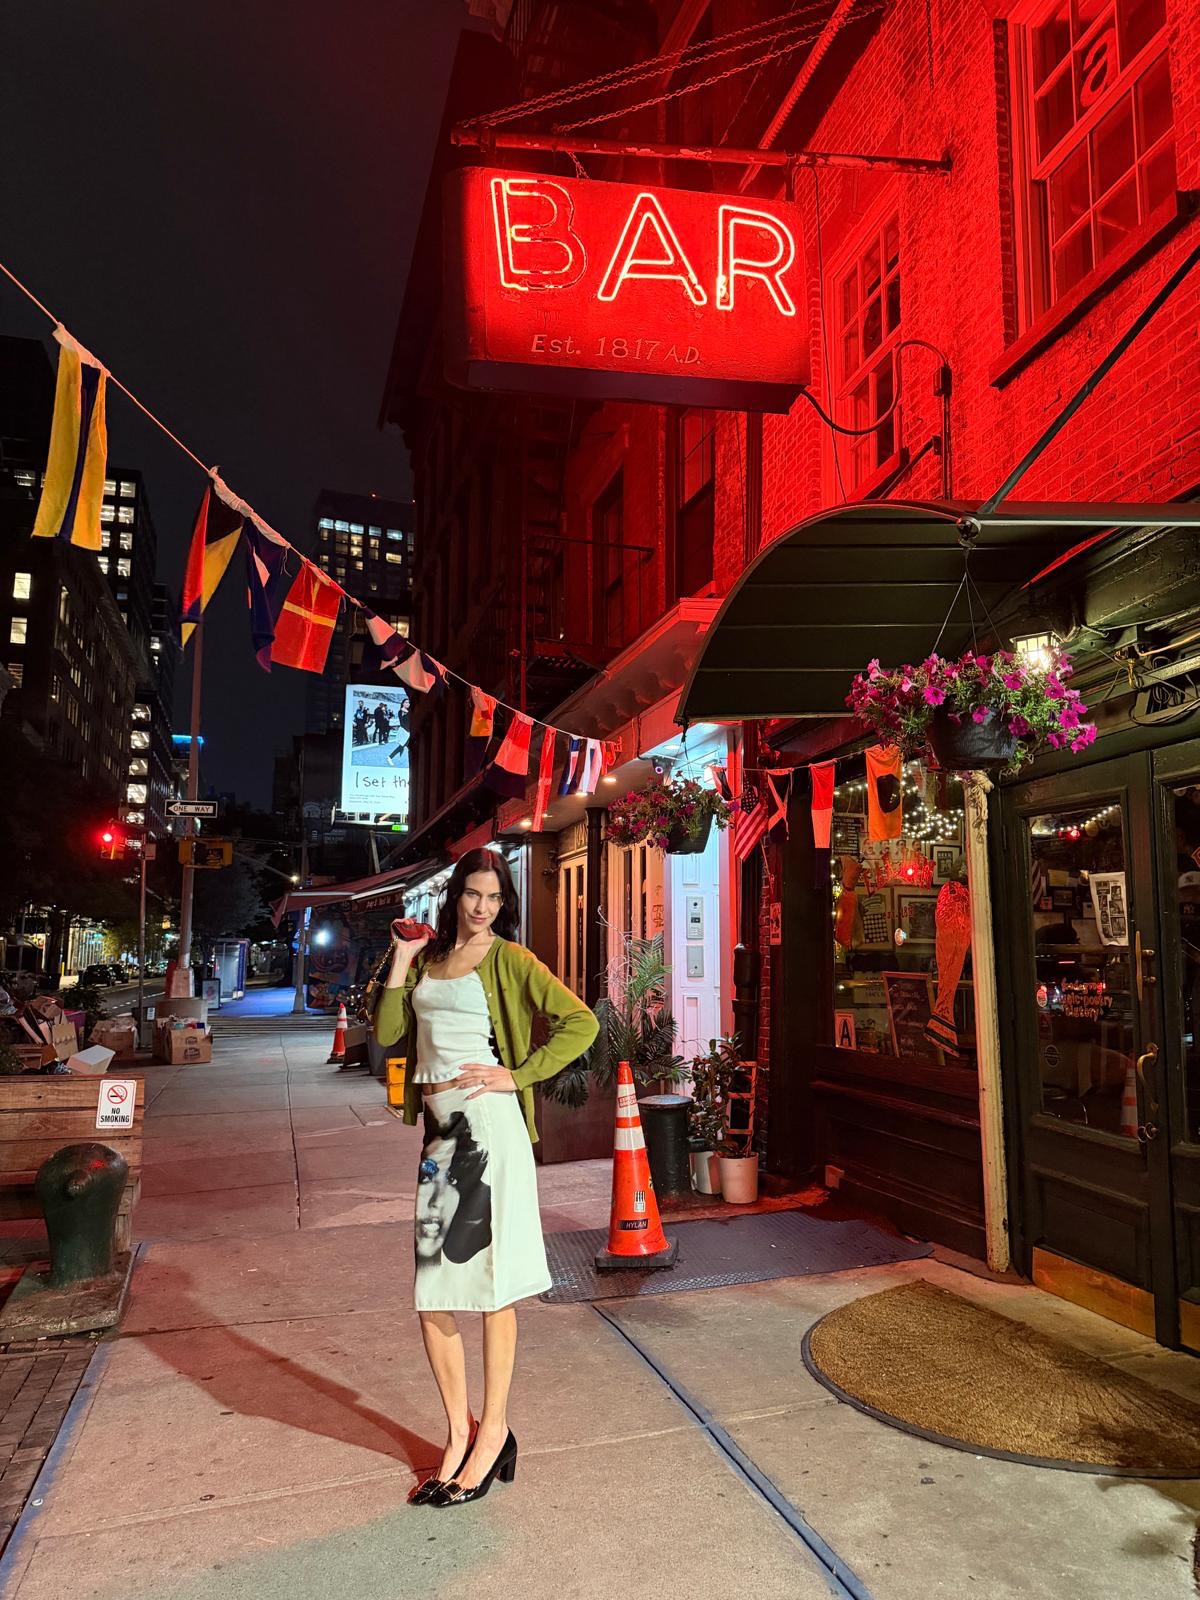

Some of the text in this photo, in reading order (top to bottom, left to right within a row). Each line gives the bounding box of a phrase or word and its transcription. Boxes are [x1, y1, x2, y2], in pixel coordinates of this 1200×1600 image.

[490, 178, 797, 317] BAR
[531, 334, 702, 364] Est. 1817 A.D.
[392, 773, 410, 789] th
[840, 1018, 852, 1047] A
[100, 1115, 130, 1123] SMOKING
[111, 1107, 121, 1115] NO
[625, 1220, 647, 1229] HYLAN
